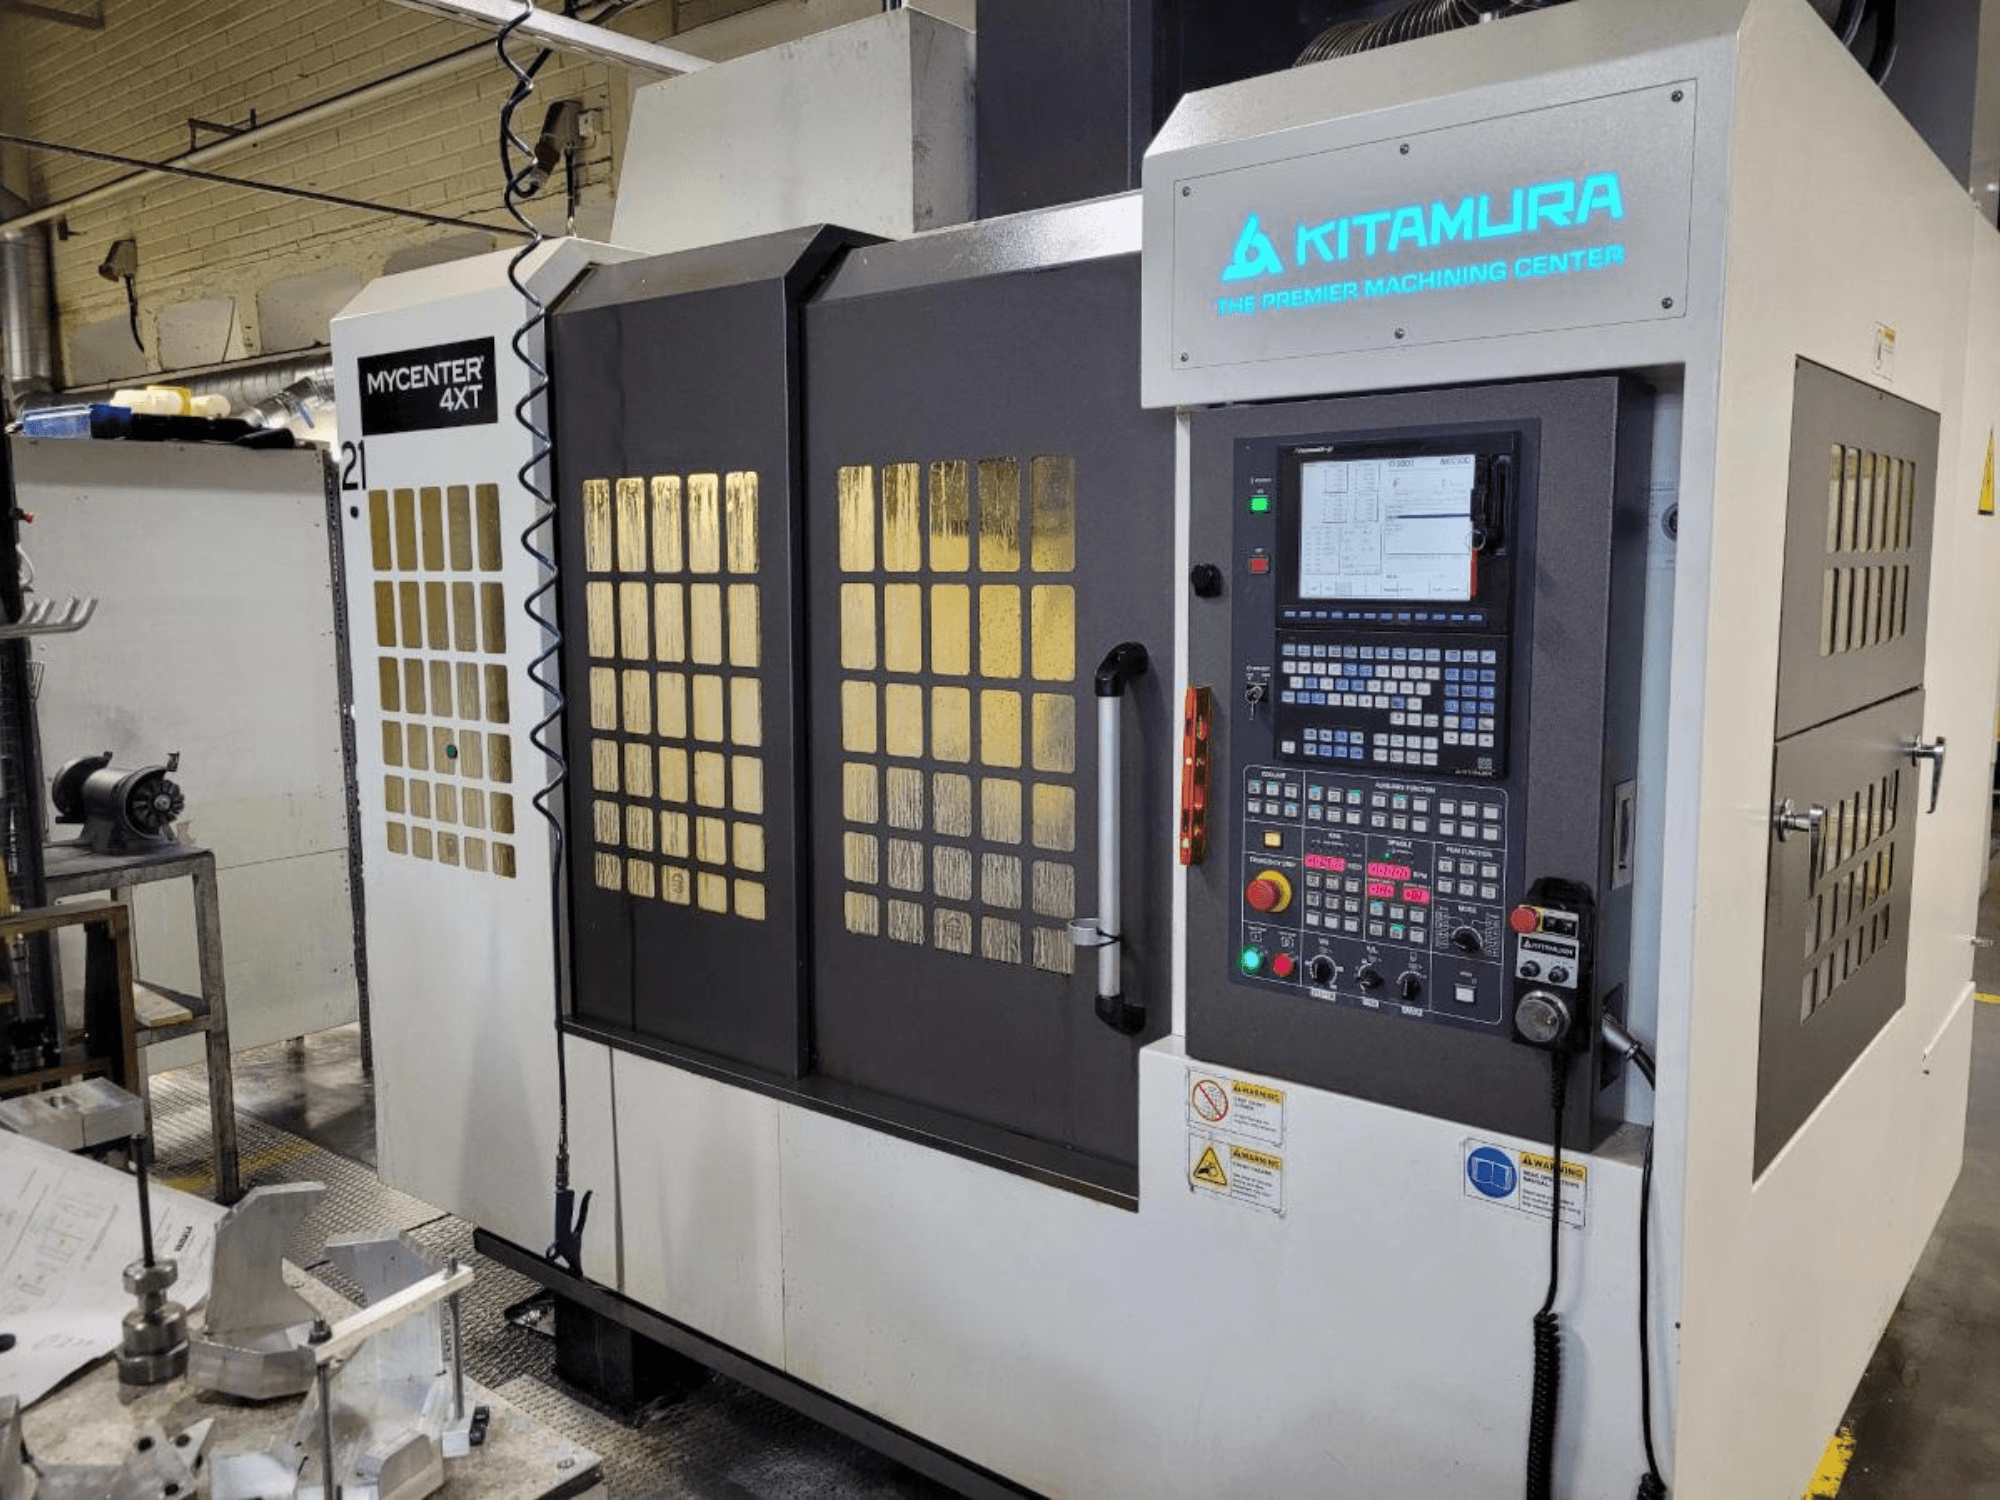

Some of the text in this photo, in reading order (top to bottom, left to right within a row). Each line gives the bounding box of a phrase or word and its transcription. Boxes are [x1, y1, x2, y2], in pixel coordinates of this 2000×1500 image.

[1296, 171, 1625, 266] KITAMURA
[1218, 244, 1625, 317] THE PREMIER MACHINING CENTER
[367, 356, 483, 395] MYCENTER
[439, 384, 483, 411] 4XT
[341, 440, 366, 491] 21
